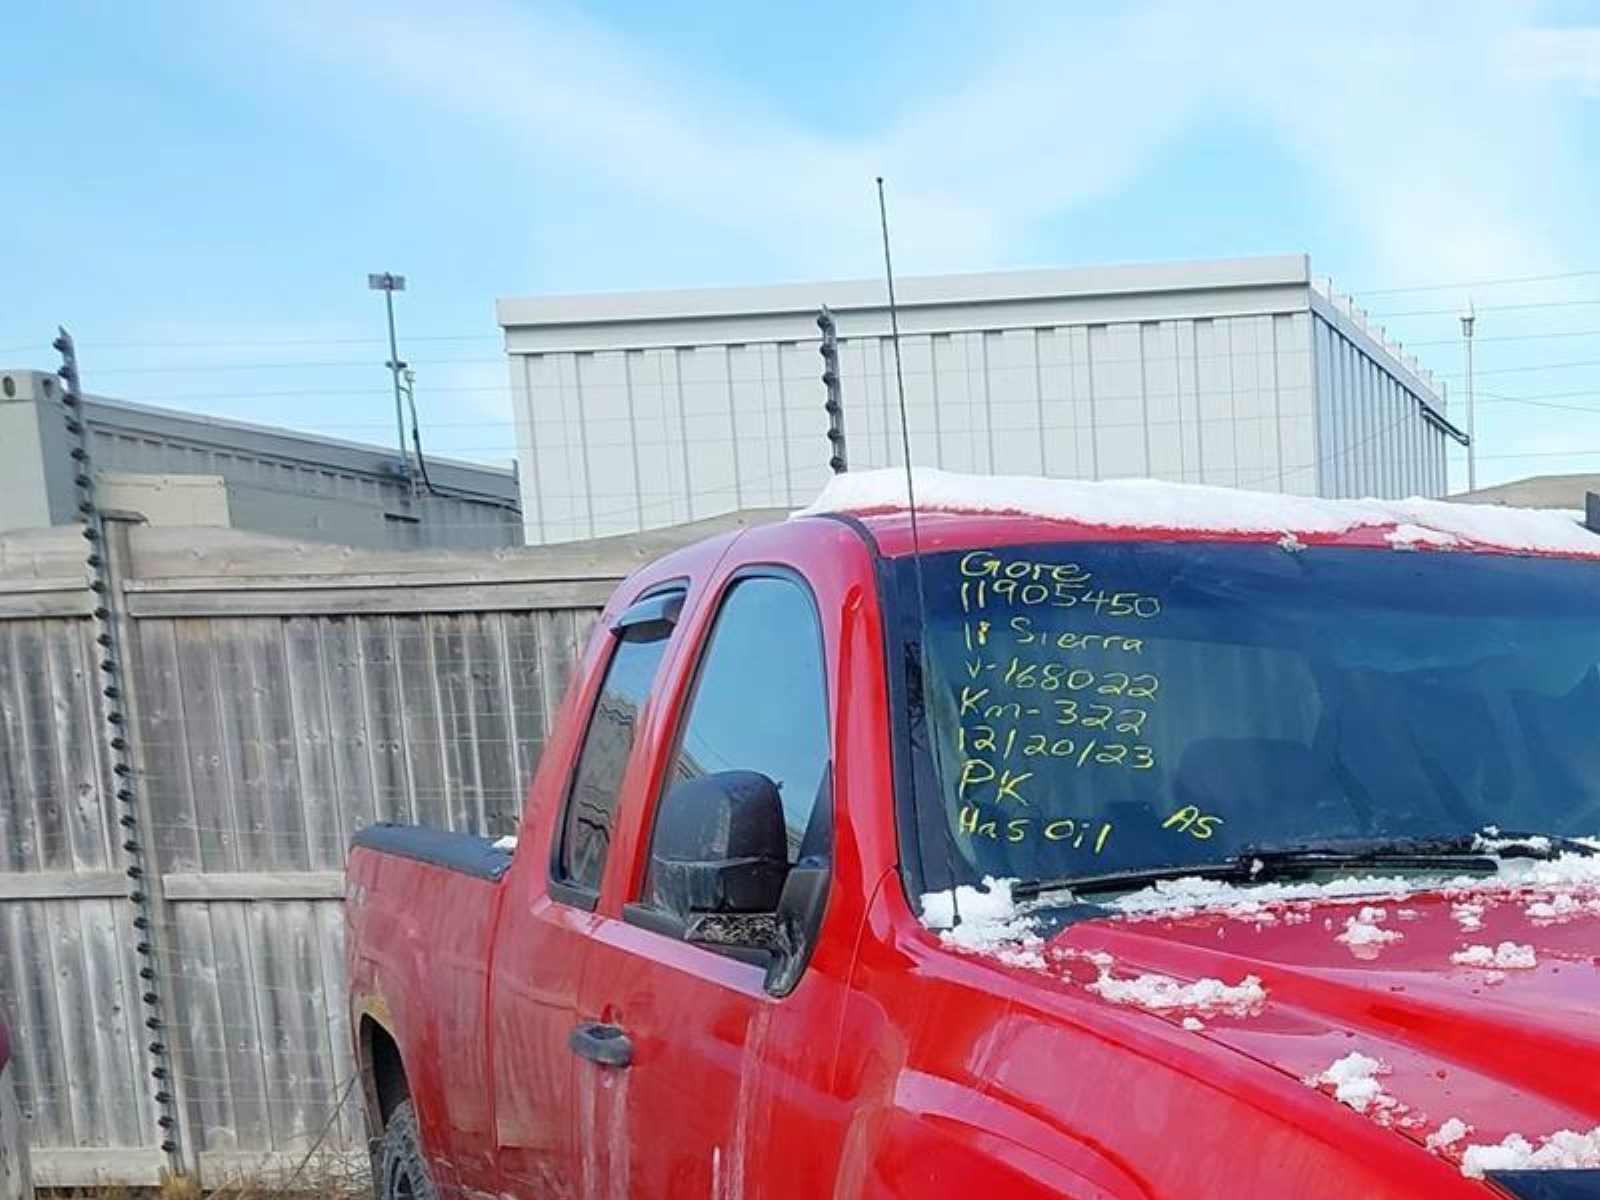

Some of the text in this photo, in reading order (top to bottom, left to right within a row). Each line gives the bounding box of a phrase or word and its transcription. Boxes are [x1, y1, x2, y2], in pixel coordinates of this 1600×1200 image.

[960, 551, 1092, 582] Gore
[961, 580, 1161, 618] 11905450
[1010, 617, 1143, 654] Sierra
[958, 727, 1154, 769] 12/20/23
